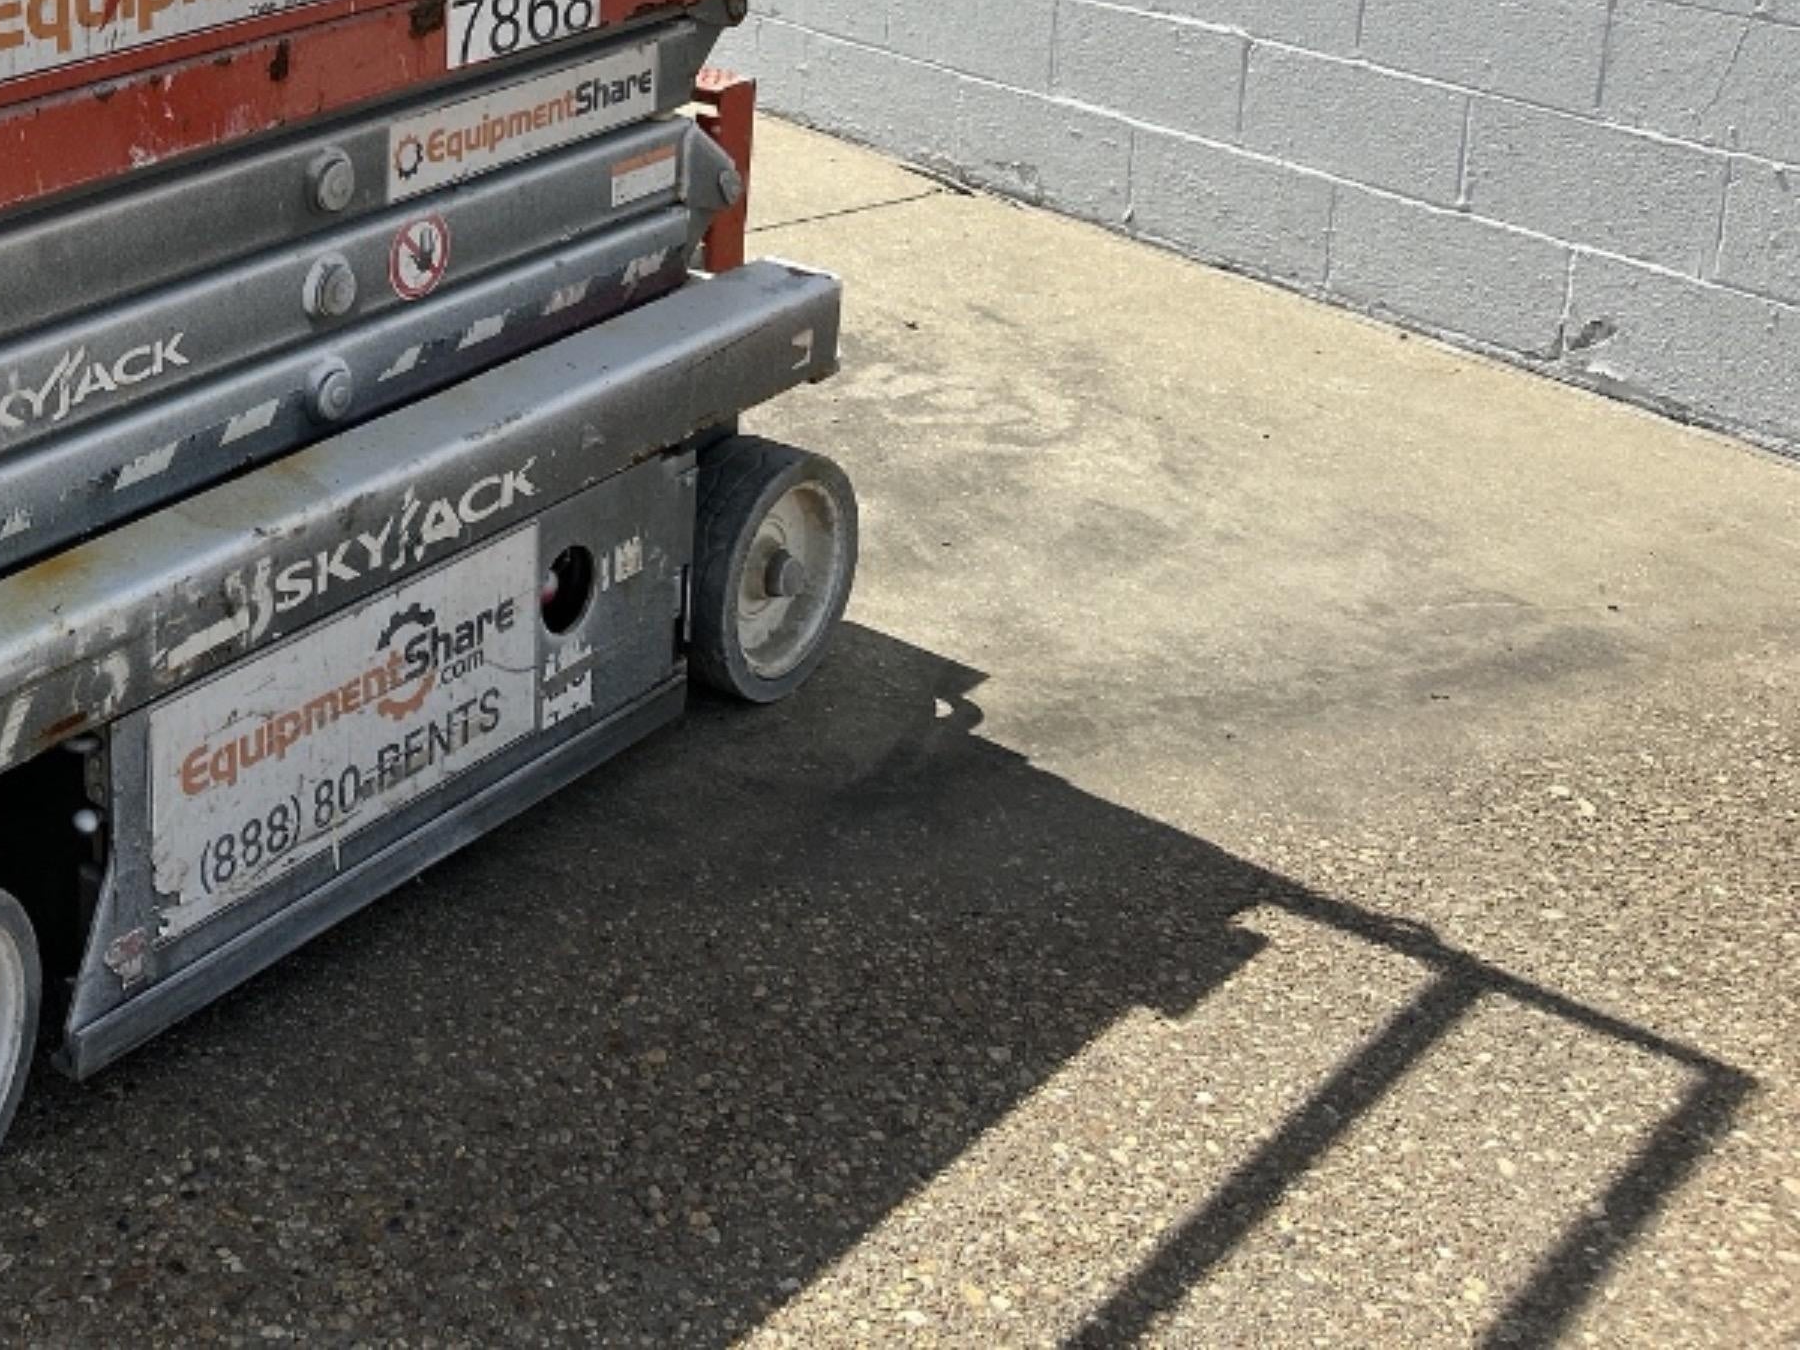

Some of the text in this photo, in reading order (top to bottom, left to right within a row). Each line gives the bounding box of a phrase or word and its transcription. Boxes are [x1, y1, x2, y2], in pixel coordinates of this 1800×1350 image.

[426, 68, 652, 164] EquipmentShare
[274, 455, 536, 615] SKYJACK
[181, 596, 515, 797] EquipmentShare
[437, 648, 485, 689] .com
[201, 793, 301, 895] (888)
